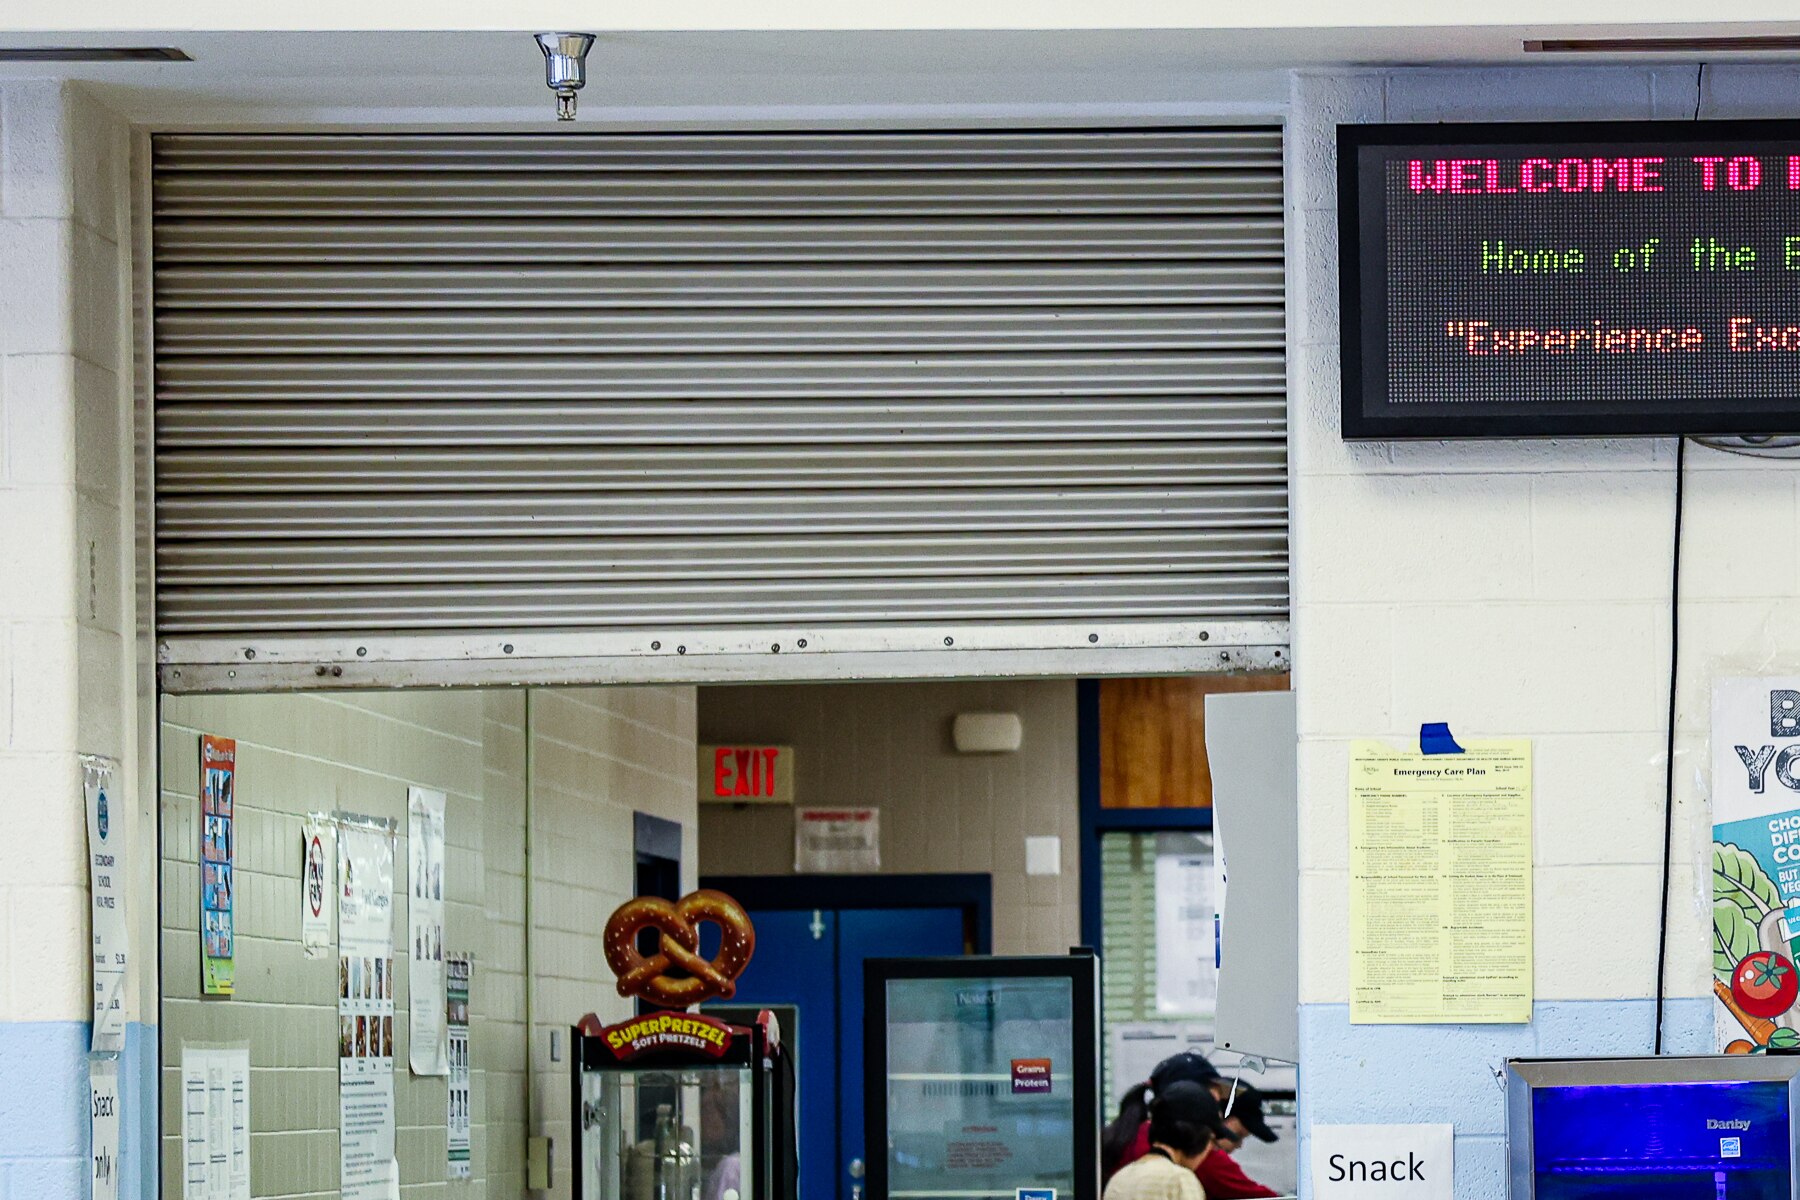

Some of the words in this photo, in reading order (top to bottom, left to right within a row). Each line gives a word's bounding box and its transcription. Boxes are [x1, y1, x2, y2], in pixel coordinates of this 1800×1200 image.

[1409, 157, 1664, 196] WELCOME
[1692, 155, 1762, 193] TO
[1481, 240, 1584, 275] Home
[1613, 238, 1659, 273] of
[1690, 236, 1757, 273] the
[1447, 319, 1703, 357] "Experience
[714, 747, 779, 796] EXIT
[1393, 768, 1441, 777] Emergency
[1778, 869, 1798, 882] BUT
[607, 1015, 726, 1049] SUPERPRETZEL
[632, 1035, 658, 1050] SOFT
[659, 1033, 706, 1049] PRETZELS
[1014, 1078, 1049, 1088] Protein
[1016, 1065, 1046, 1074] Grains
[93, 1088, 114, 1118] Snack
[1707, 1118, 1751, 1131] Danby
[1329, 1151, 1425, 1182] Snack
